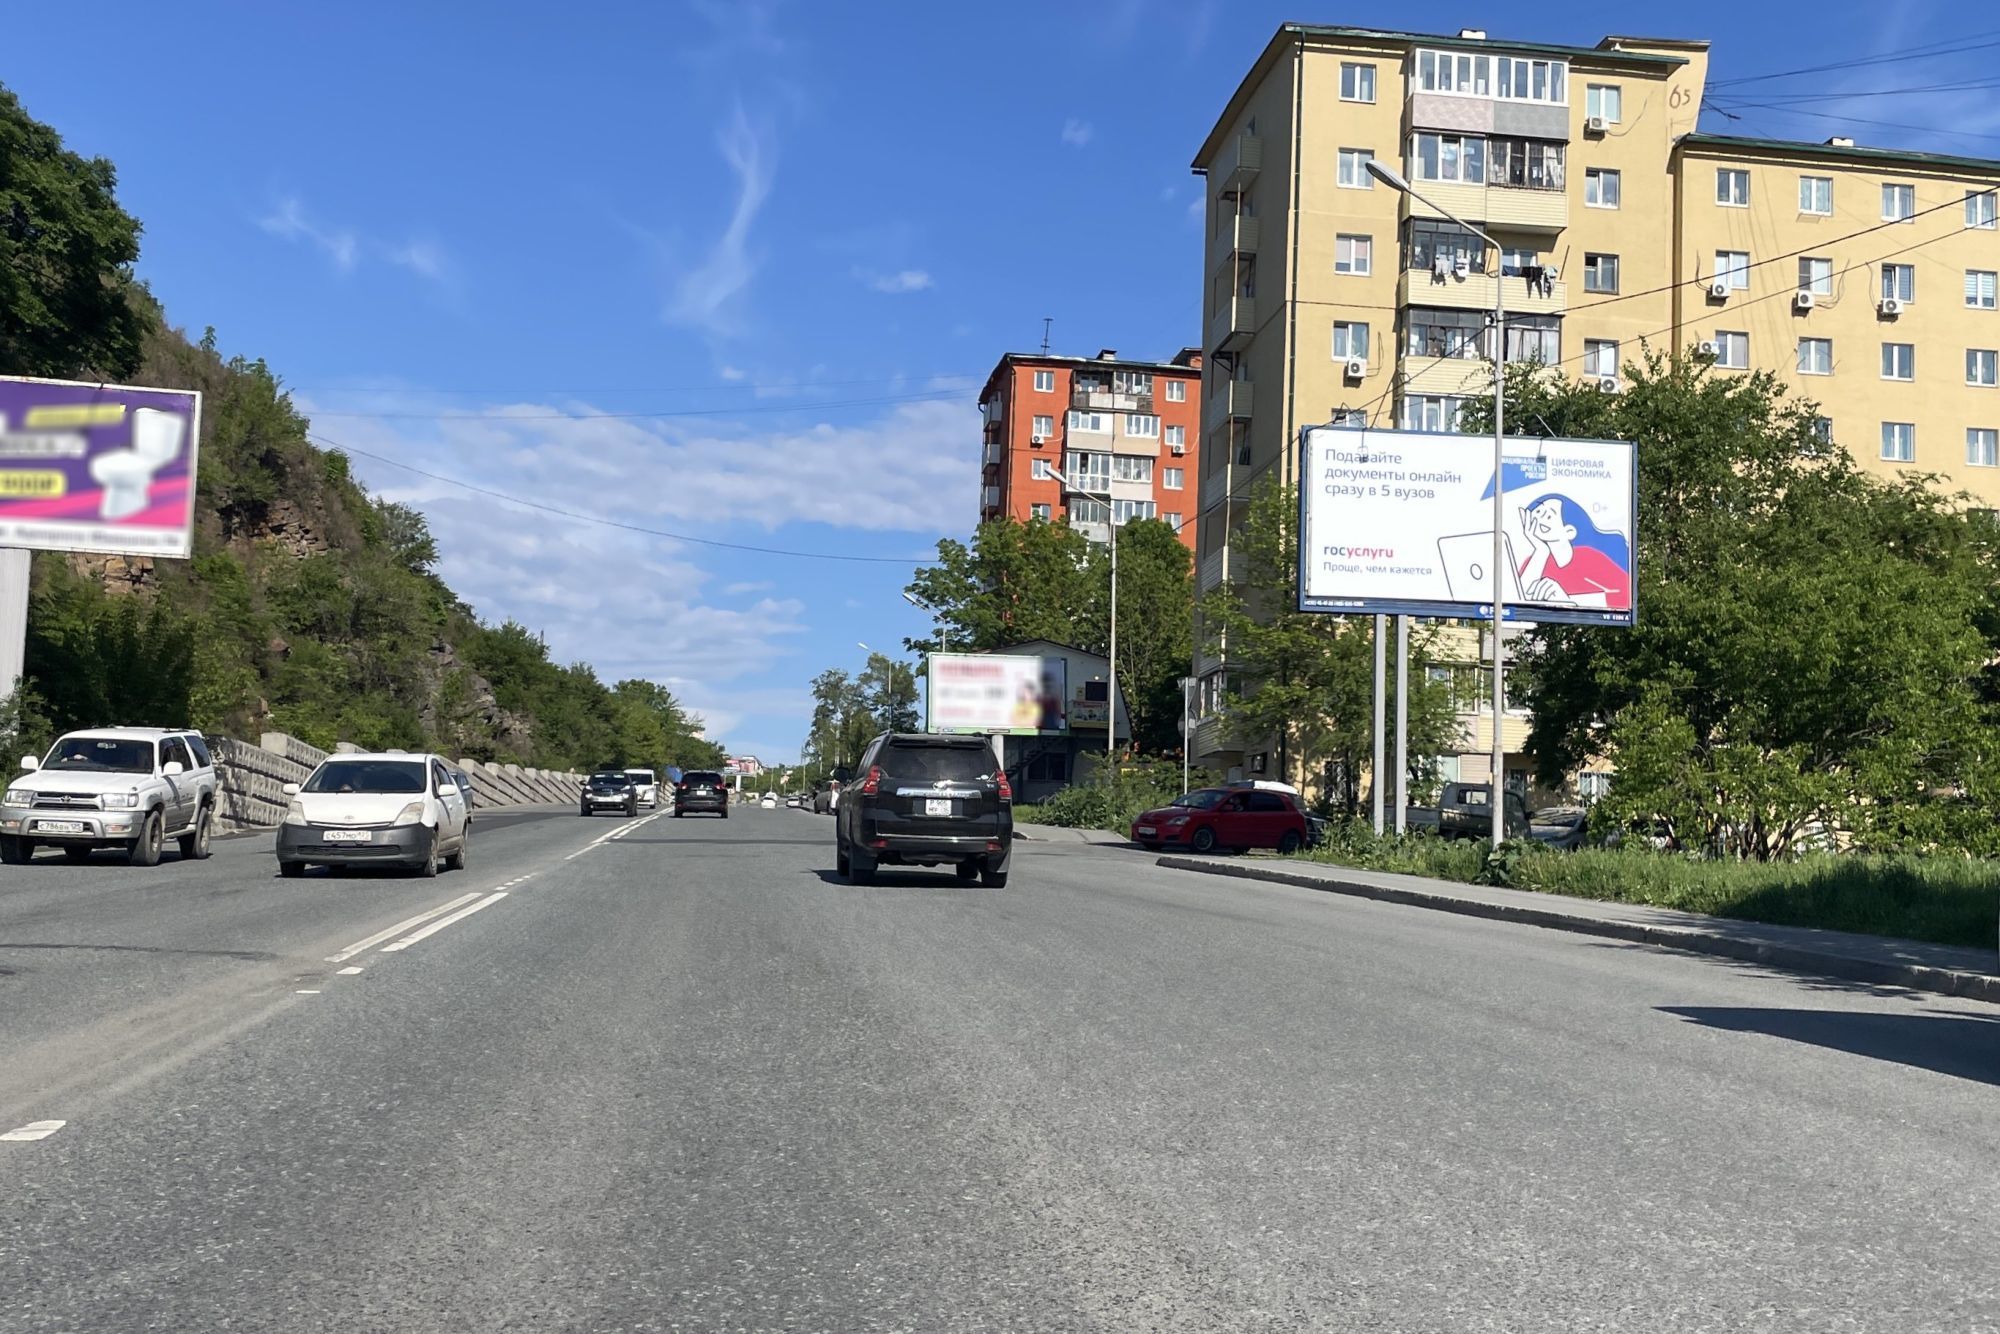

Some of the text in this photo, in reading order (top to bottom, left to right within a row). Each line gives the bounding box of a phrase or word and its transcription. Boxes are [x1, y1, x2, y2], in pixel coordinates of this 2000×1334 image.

[1669, 83, 1691, 109] 65
[1325, 448, 1402, 464] Подавайте
[1552, 458, 1604, 468] ЦИФРОВАЯ
[1324, 467, 1462, 484] документы онлайн
[1552, 468, 1612, 479] ЭКОНОМИКА
[1324, 484, 1435, 501] сразу в 5 вузов
[1323, 546, 1393, 560] госуслуги
[1323, 562, 1432, 575] Проще, чем кажется
